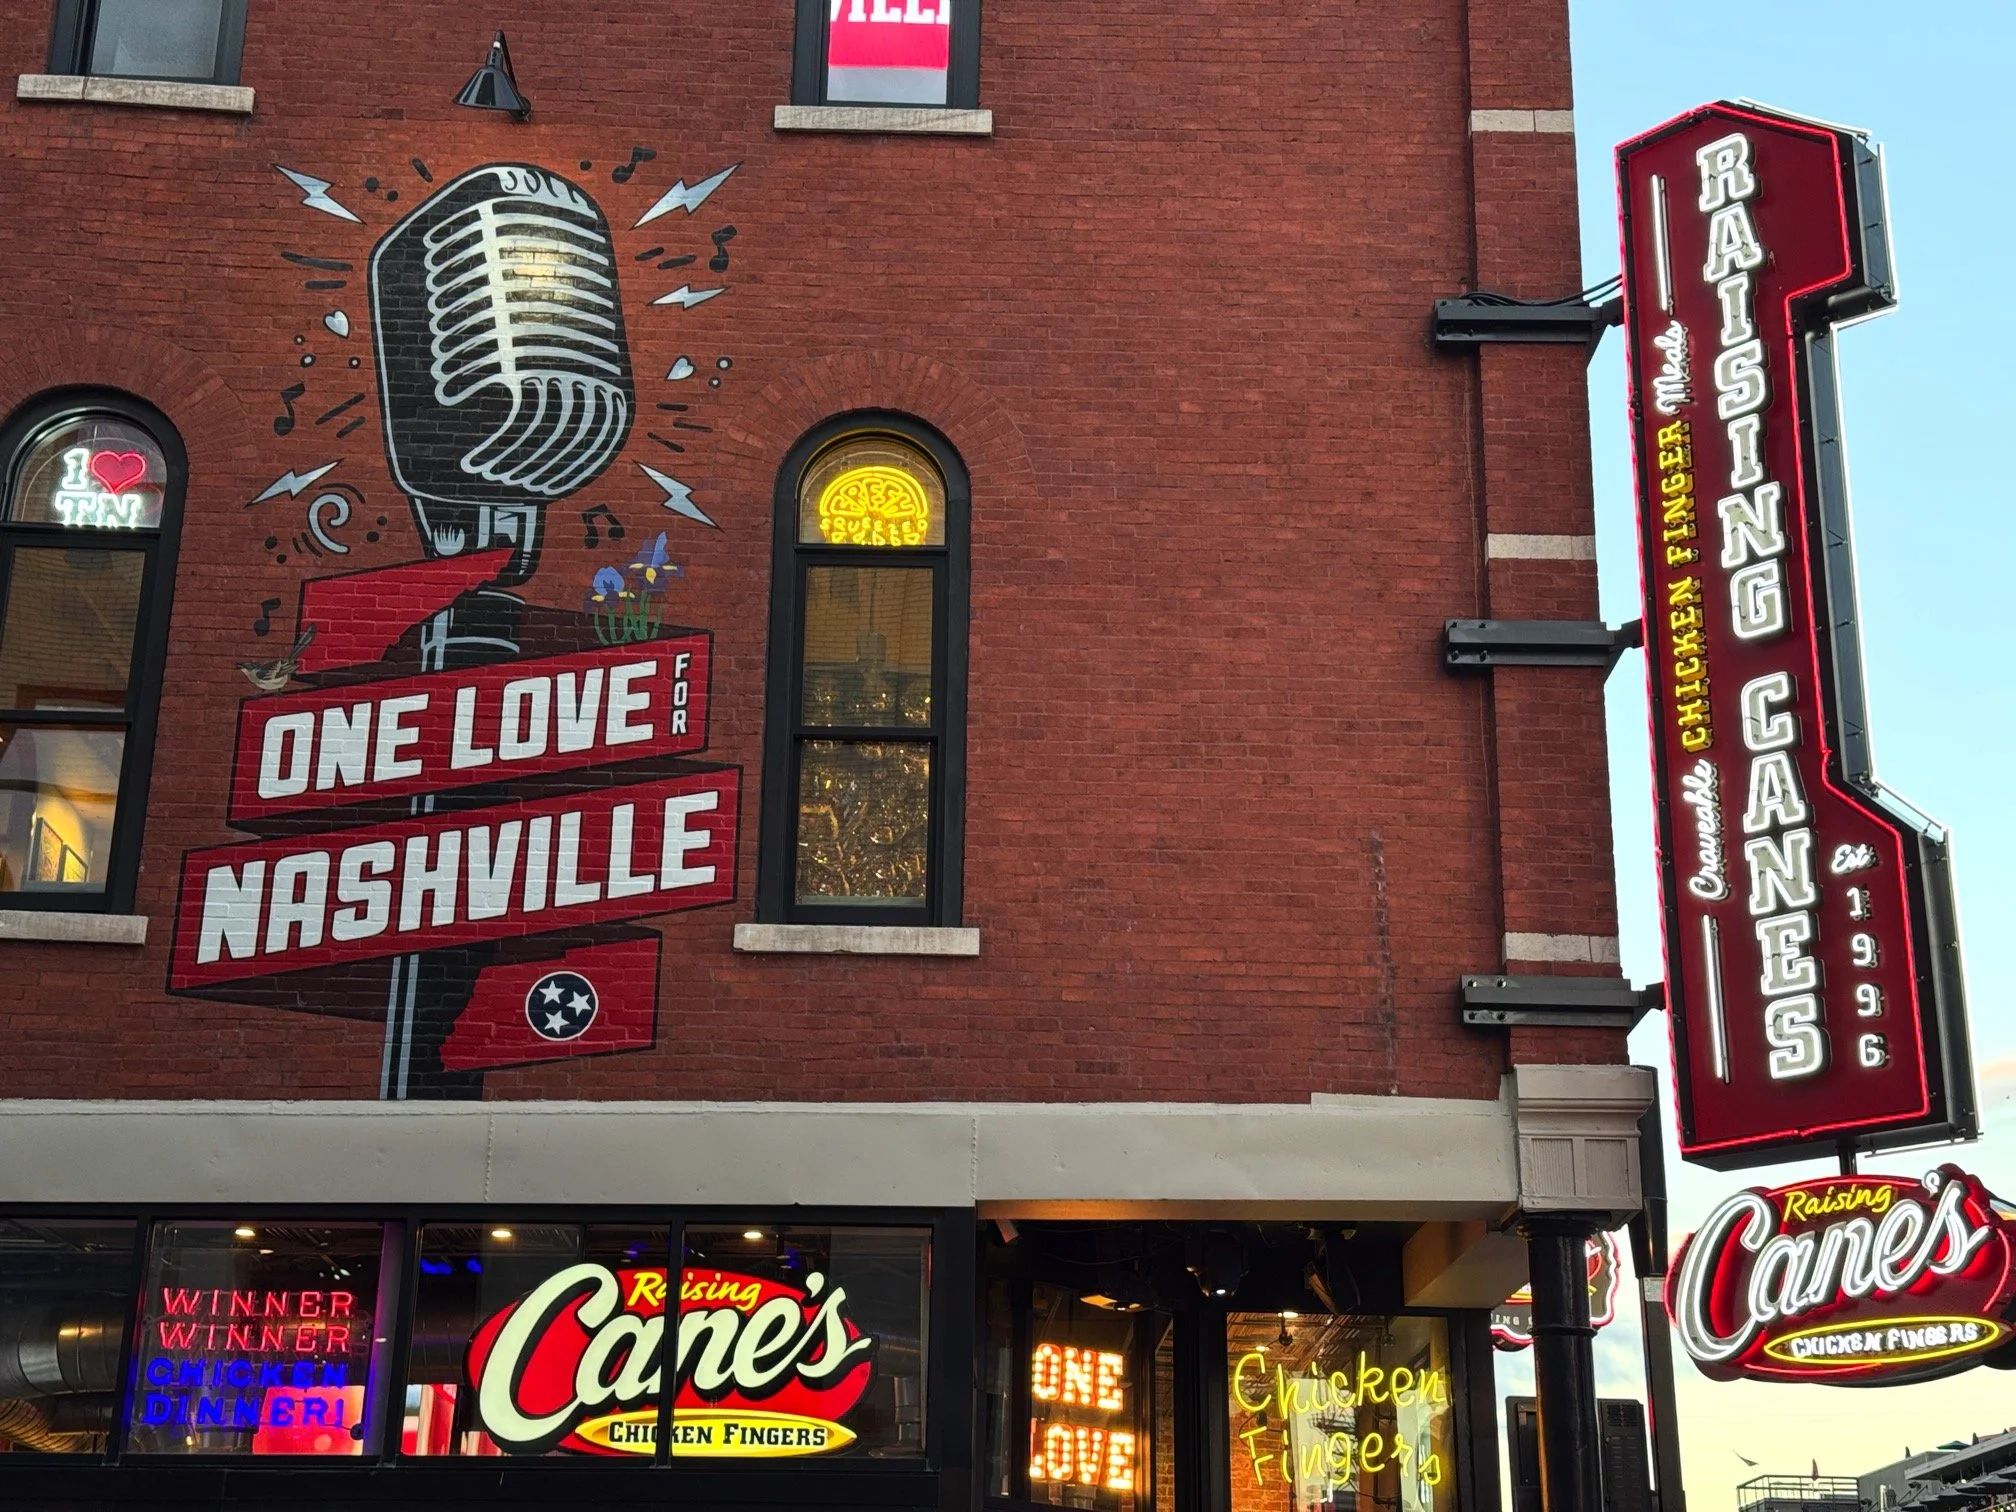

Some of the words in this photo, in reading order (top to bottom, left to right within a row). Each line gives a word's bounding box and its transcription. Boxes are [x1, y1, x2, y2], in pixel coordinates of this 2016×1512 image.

[1653, 319, 1688, 415] Meals
[1697, 133, 1788, 641] RAISING
[54, 490, 142, 529] TN
[1658, 419, 1692, 566] FINGER
[1667, 575, 1708, 750] CHICKEN
[257, 692, 430, 800] ONE
[450, 659, 658, 771] LOVE
[670, 652, 691, 737] FOR
[1683, 758, 1722, 899] Craveable
[196, 789, 719, 965] NASHVILLE
[1740, 671, 1826, 1080] CANES
[1846, 887, 1882, 1067] 1996
[1783, 1184, 1892, 1223] Raising
[161, 1286, 353, 1318] WINNER
[1676, 1169, 1991, 1362] Cane's
[146, 1357, 348, 1388] CHICKEN
[158, 1321, 351, 1353] WINNER
[480, 1263, 872, 1442] Cane's
[1791, 1331, 1882, 1359] CHICKEN
[1887, 1322, 1978, 1350] FINGERS
[143, 1391, 345, 1427] DINNER!
[1032, 1343, 1123, 1411] ONE
[1233, 1350, 1447, 1420] Chicken
[722, 1422, 826, 1447] FINGERS
[1029, 1417, 1136, 1490] LOVE
[1240, 1426, 1442, 1487] Fingers
